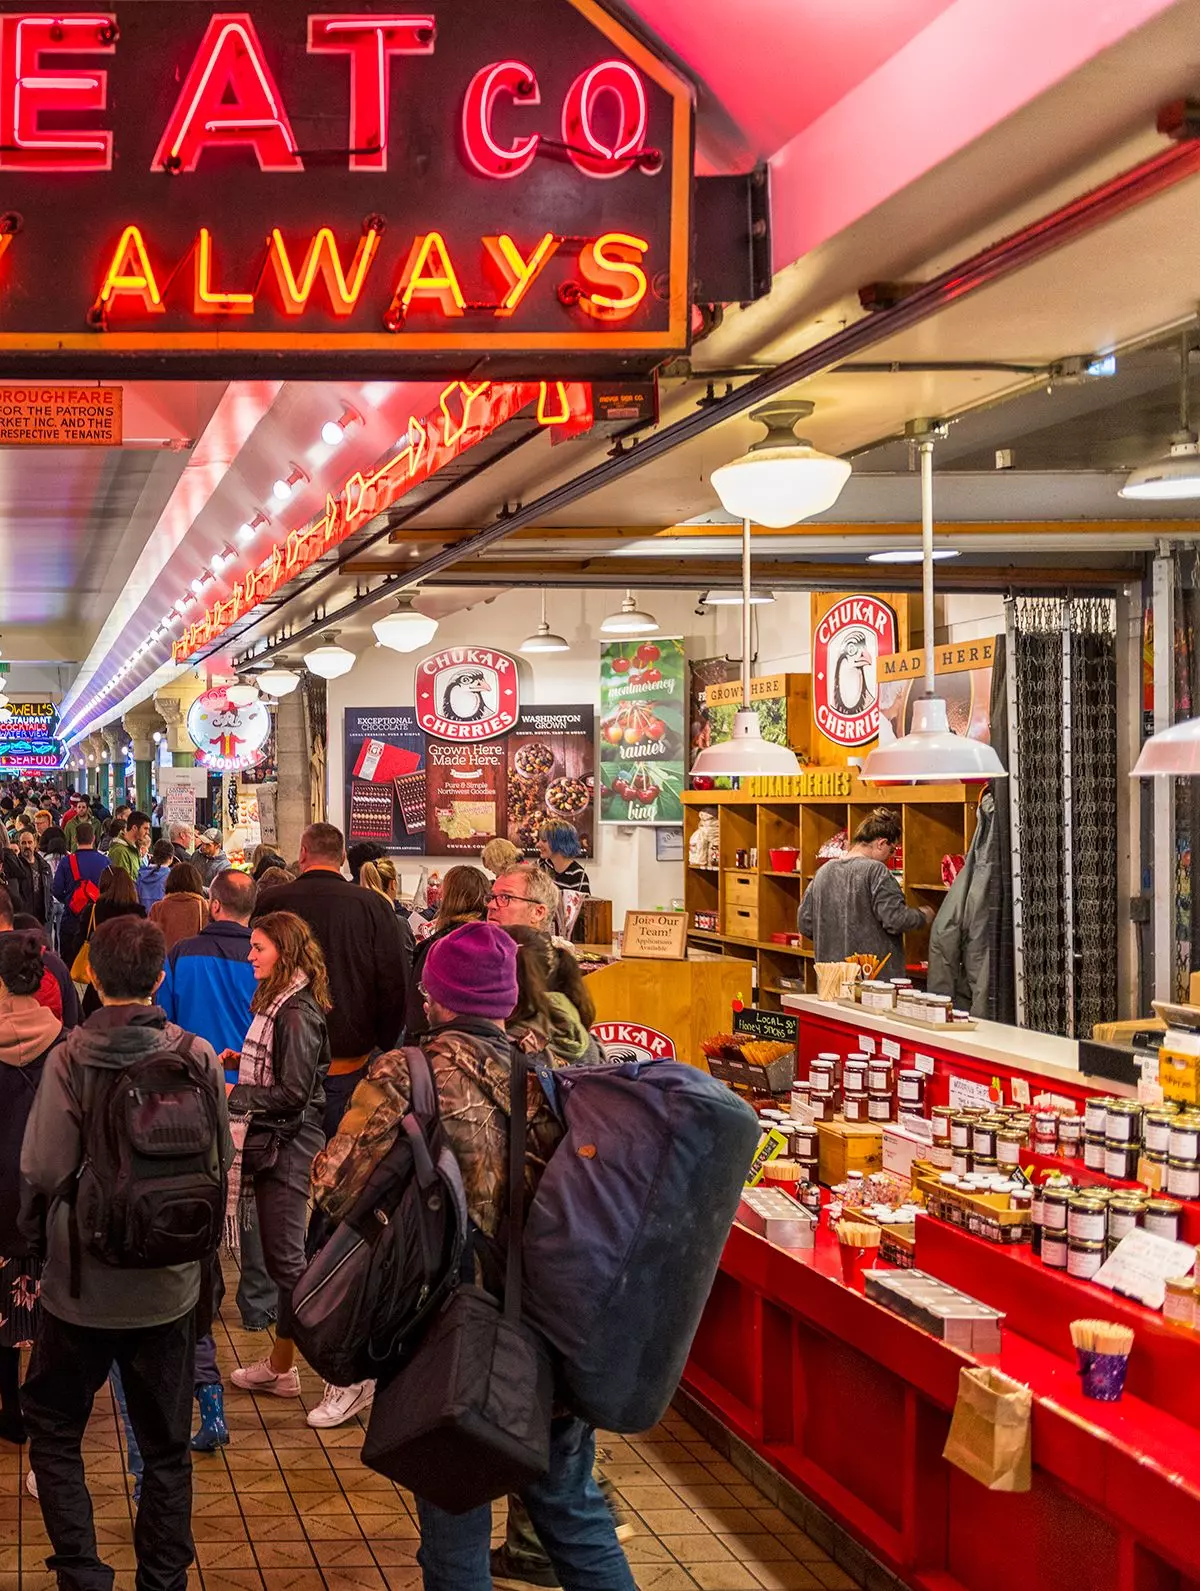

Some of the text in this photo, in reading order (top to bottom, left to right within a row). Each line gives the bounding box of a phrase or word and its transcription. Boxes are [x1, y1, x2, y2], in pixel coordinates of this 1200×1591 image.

[462, 60, 650, 180] CO
[96, 226, 651, 322] ALWAYS
[27, 406, 52, 416] THE
[56, 407, 114, 417] PATRONS
[34, 418, 57, 428] INC.
[60, 418, 90, 428] AND
[90, 418, 112, 428] THE
[0, 430, 60, 439] RESPECTIVE
[64, 430, 113, 439] TENANTS
[819, 601, 888, 643] CHUKAR
[422, 649, 510, 676] CHUKAR
[884, 645, 992, 674] MAD HERE
[751, 680, 780, 694] HERE
[357, 716, 413, 725] EXCEPTIONAL
[422, 711, 513, 738] CHERRIES
[521, 714, 581, 723] WASHINGTON
[817, 704, 880, 739] CHERRIE
[0, 723, 47, 731] COCKTAILS
[29, 730, 49, 738] VIEW
[361, 723, 409, 731] CHOCOLATE
[428, 744, 505, 755] Grown Here.
[619, 740, 666, 759] rainier
[9, 756, 57, 765] SEAFOOD
[203, 752, 254, 769] PRODUCE
[432, 755, 501, 766] Made Here.
[793, 772, 852, 797] CHERRIES
[627, 801, 658, 821] bing
[632, 915, 680, 926] Join Our
[640, 927, 672, 937] Team!
[756, 1012, 784, 1027] LOCAL
[590, 1025, 667, 1056] UKAR
